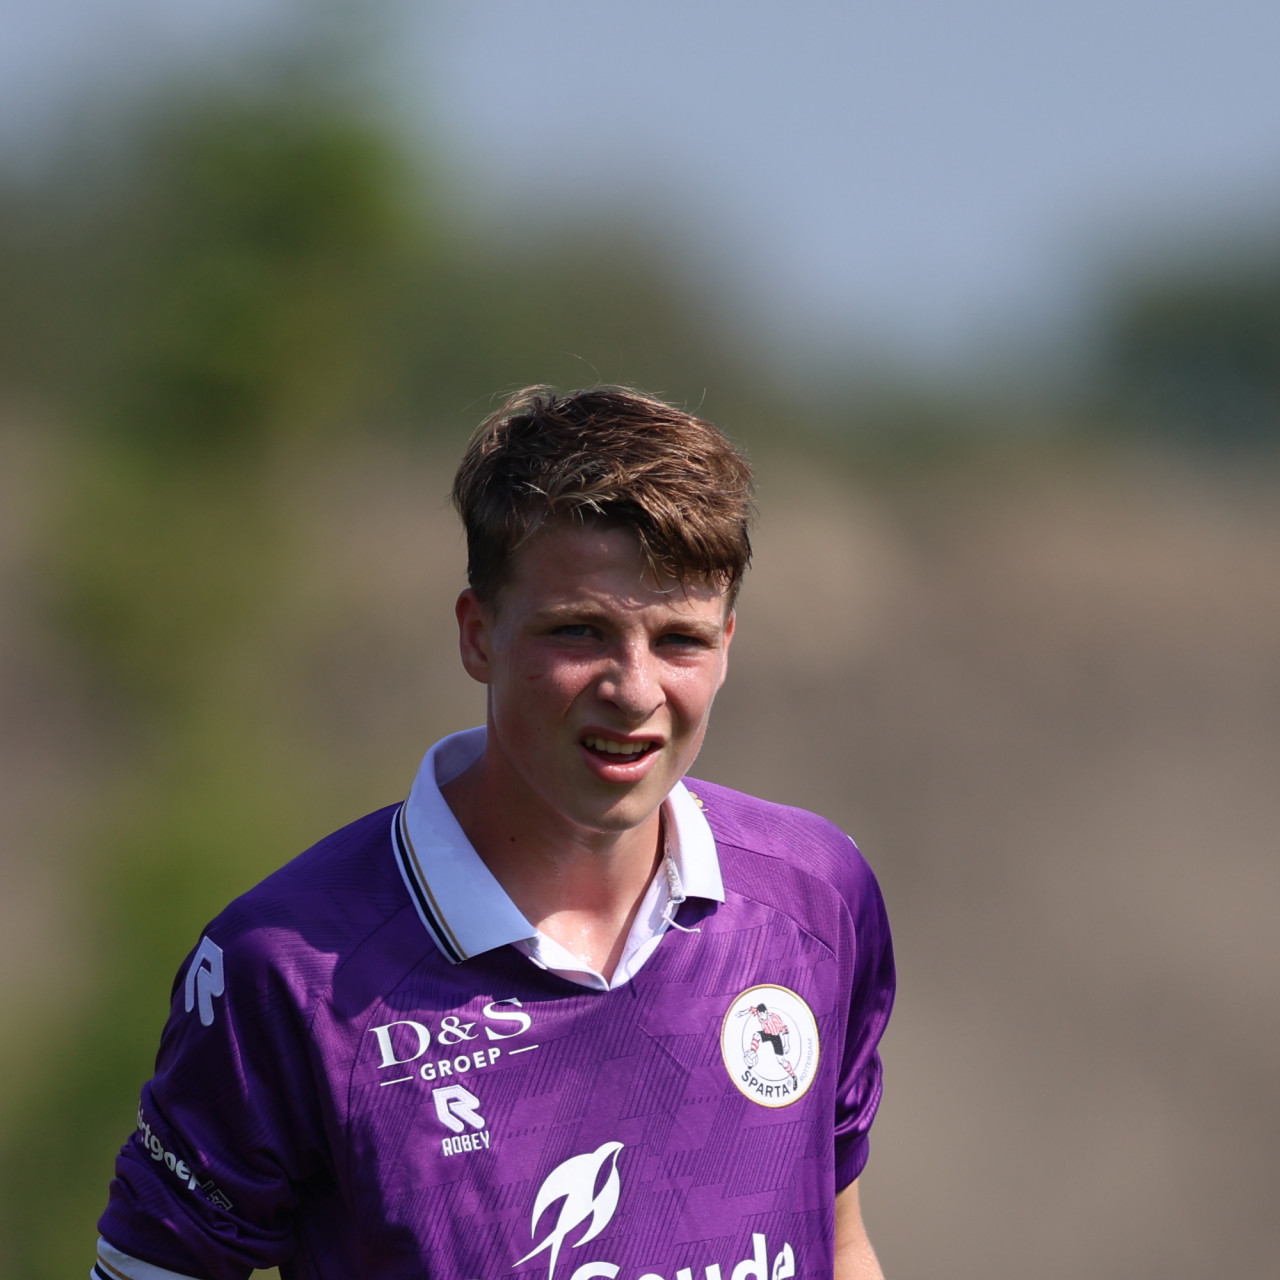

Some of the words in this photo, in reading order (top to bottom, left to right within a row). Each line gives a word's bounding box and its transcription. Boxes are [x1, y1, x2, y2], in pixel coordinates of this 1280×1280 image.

[369, 997, 532, 1069] D&S
[420, 1047, 501, 1081] GROEP
[799, 1037, 814, 1083] ROTTERDAM
[741, 1070, 791, 1098] SPARTA
[441, 1130, 491, 1157] ROBEY
